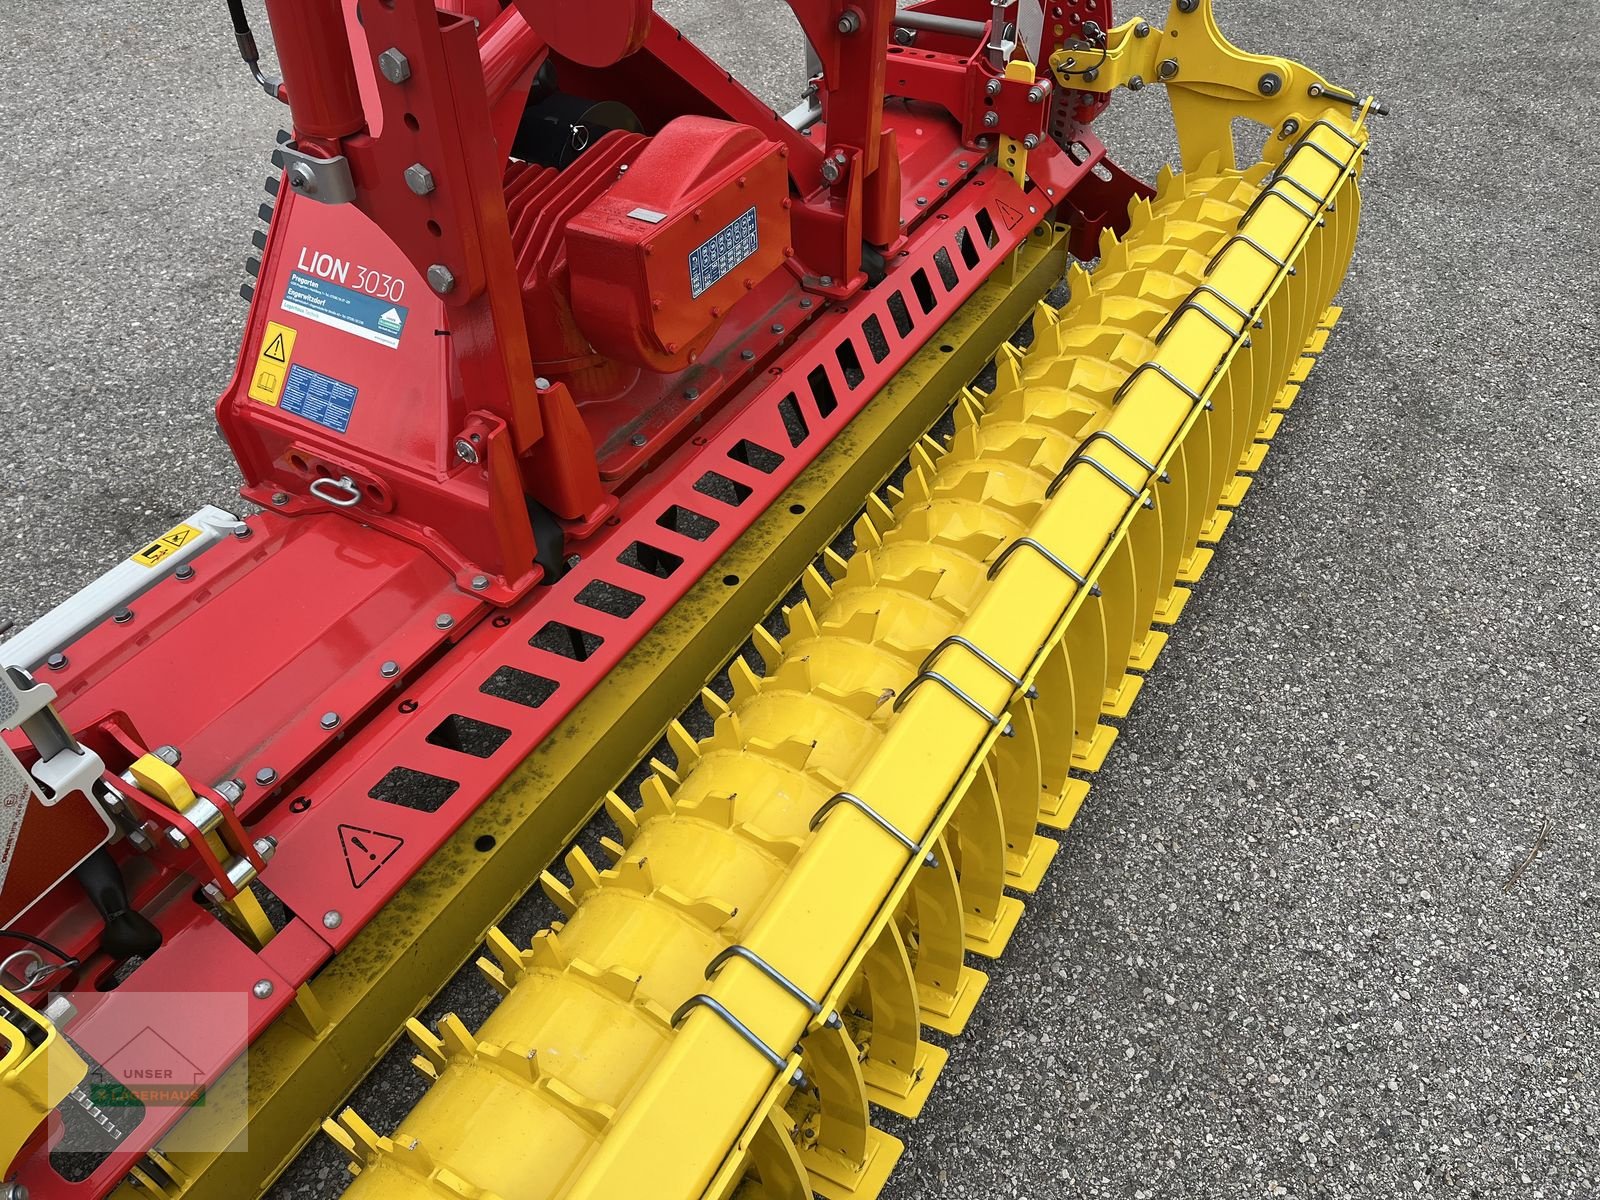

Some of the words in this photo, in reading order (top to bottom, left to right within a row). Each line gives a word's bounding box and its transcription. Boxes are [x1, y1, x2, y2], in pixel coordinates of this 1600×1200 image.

[291, 273, 319, 288] Pregarten
[297, 247, 350, 284] LION
[352, 265, 405, 303] 3030
[287, 288, 326, 306] Engerwitzdorf
